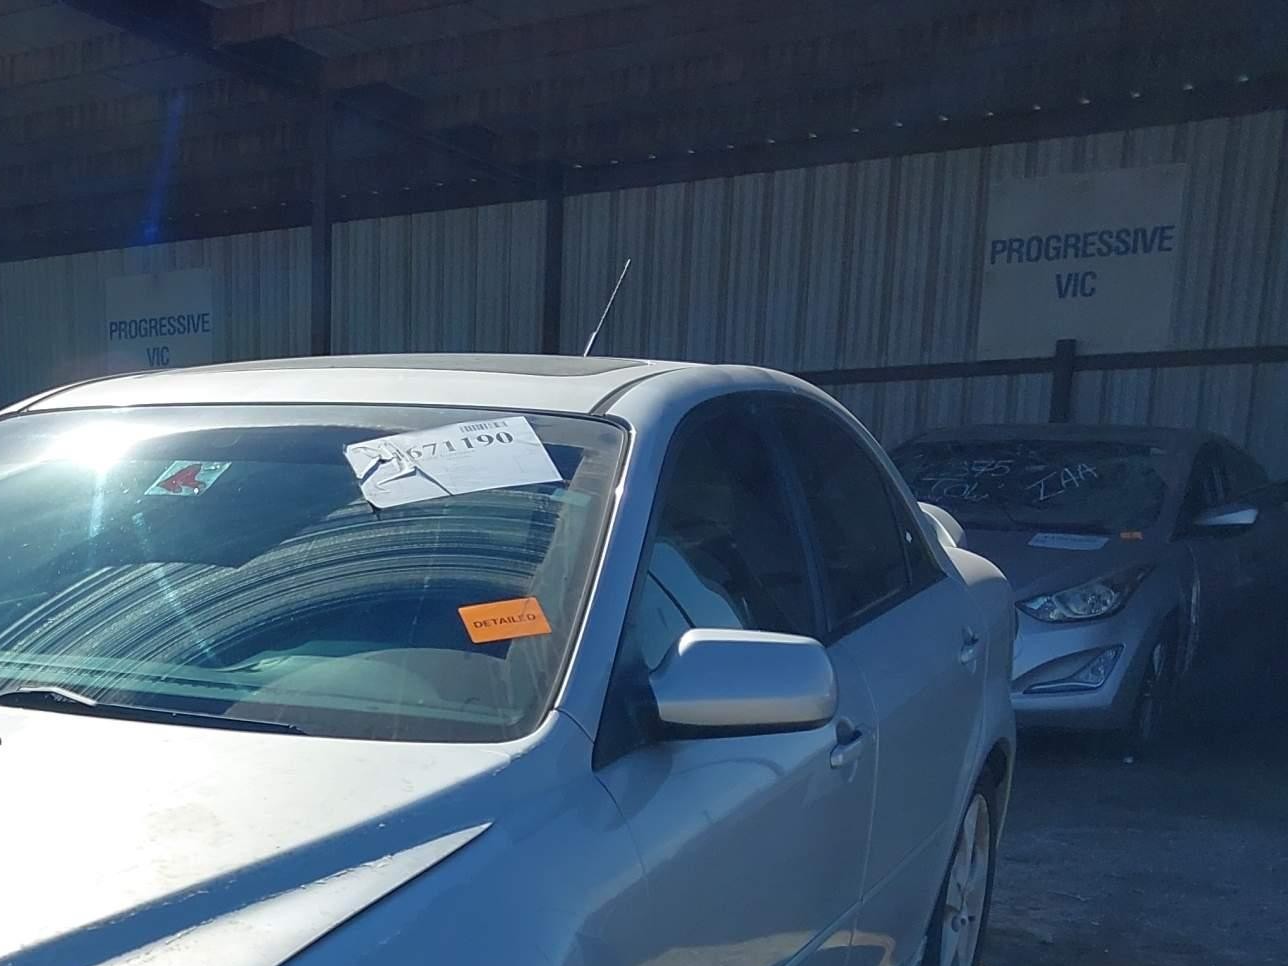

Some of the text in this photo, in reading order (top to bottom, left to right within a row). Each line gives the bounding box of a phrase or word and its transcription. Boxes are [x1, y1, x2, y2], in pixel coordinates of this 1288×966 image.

[990, 225, 1176, 265] PROGRESSIVE
[1055, 271, 1098, 299] VIC
[109, 312, 211, 340] PROGRESSIVE
[146, 346, 171, 367] VIC
[472, 613, 537, 629] DETAILED
